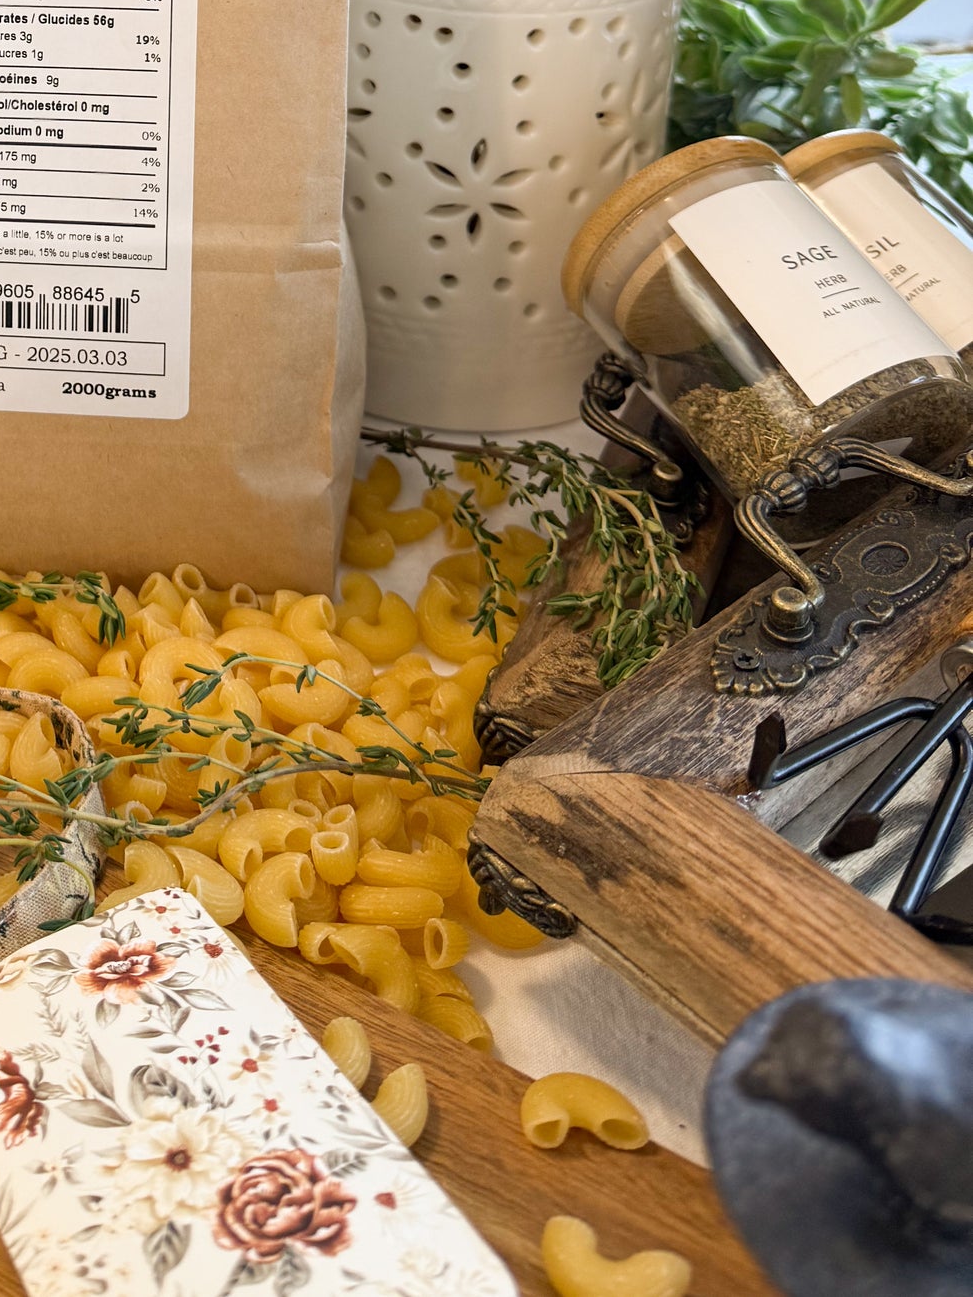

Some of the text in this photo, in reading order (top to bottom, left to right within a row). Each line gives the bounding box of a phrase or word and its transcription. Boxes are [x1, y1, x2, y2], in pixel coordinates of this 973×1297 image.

[38, 14, 89, 25] Glucides
[93, 15, 114, 28] 56g
[20, 31, 32, 44] 3g
[136, 35, 160, 45] 19%
[32, 49, 43, 61] 1g
[145, 53, 161, 63] 1%
[47, 75, 59, 87] 9g
[81, 101, 87, 112] 0
[91, 104, 109, 115] mg
[35, 126, 42, 136] 0
[46, 128, 63, 139] mg
[142, 131, 161, 141] 0%
[0, 151, 18, 161] 175
[21, 154, 36, 164] mg
[141, 157, 161, 167] 4%
[2, 179, 17, 189] mg
[142, 183, 160, 193] 2%
[11, 205, 26, 215] mg
[134, 208, 158, 218] 14%
[11, 230, 31, 239] little,
[36, 230, 54, 240] 15%
[94, 233, 102, 242] is
[113, 234, 123, 243] lot
[19, 249, 36, 257] peu,
[39, 248, 57, 257] 15%
[72, 250, 89, 259] plus
[91, 251, 110, 259] c'est
[112, 251, 152, 262] beaucoup
[781, 245, 838, 270] SAGE
[814, 274, 848, 289] HERB
[53, 286, 104, 302] 88645
[130, 289, 140, 304] 5
[822, 296, 881, 318] ALL NATURAL
[27, 347, 127, 366] 2025.03.03
[62, 382, 156, 400] 2000grams
